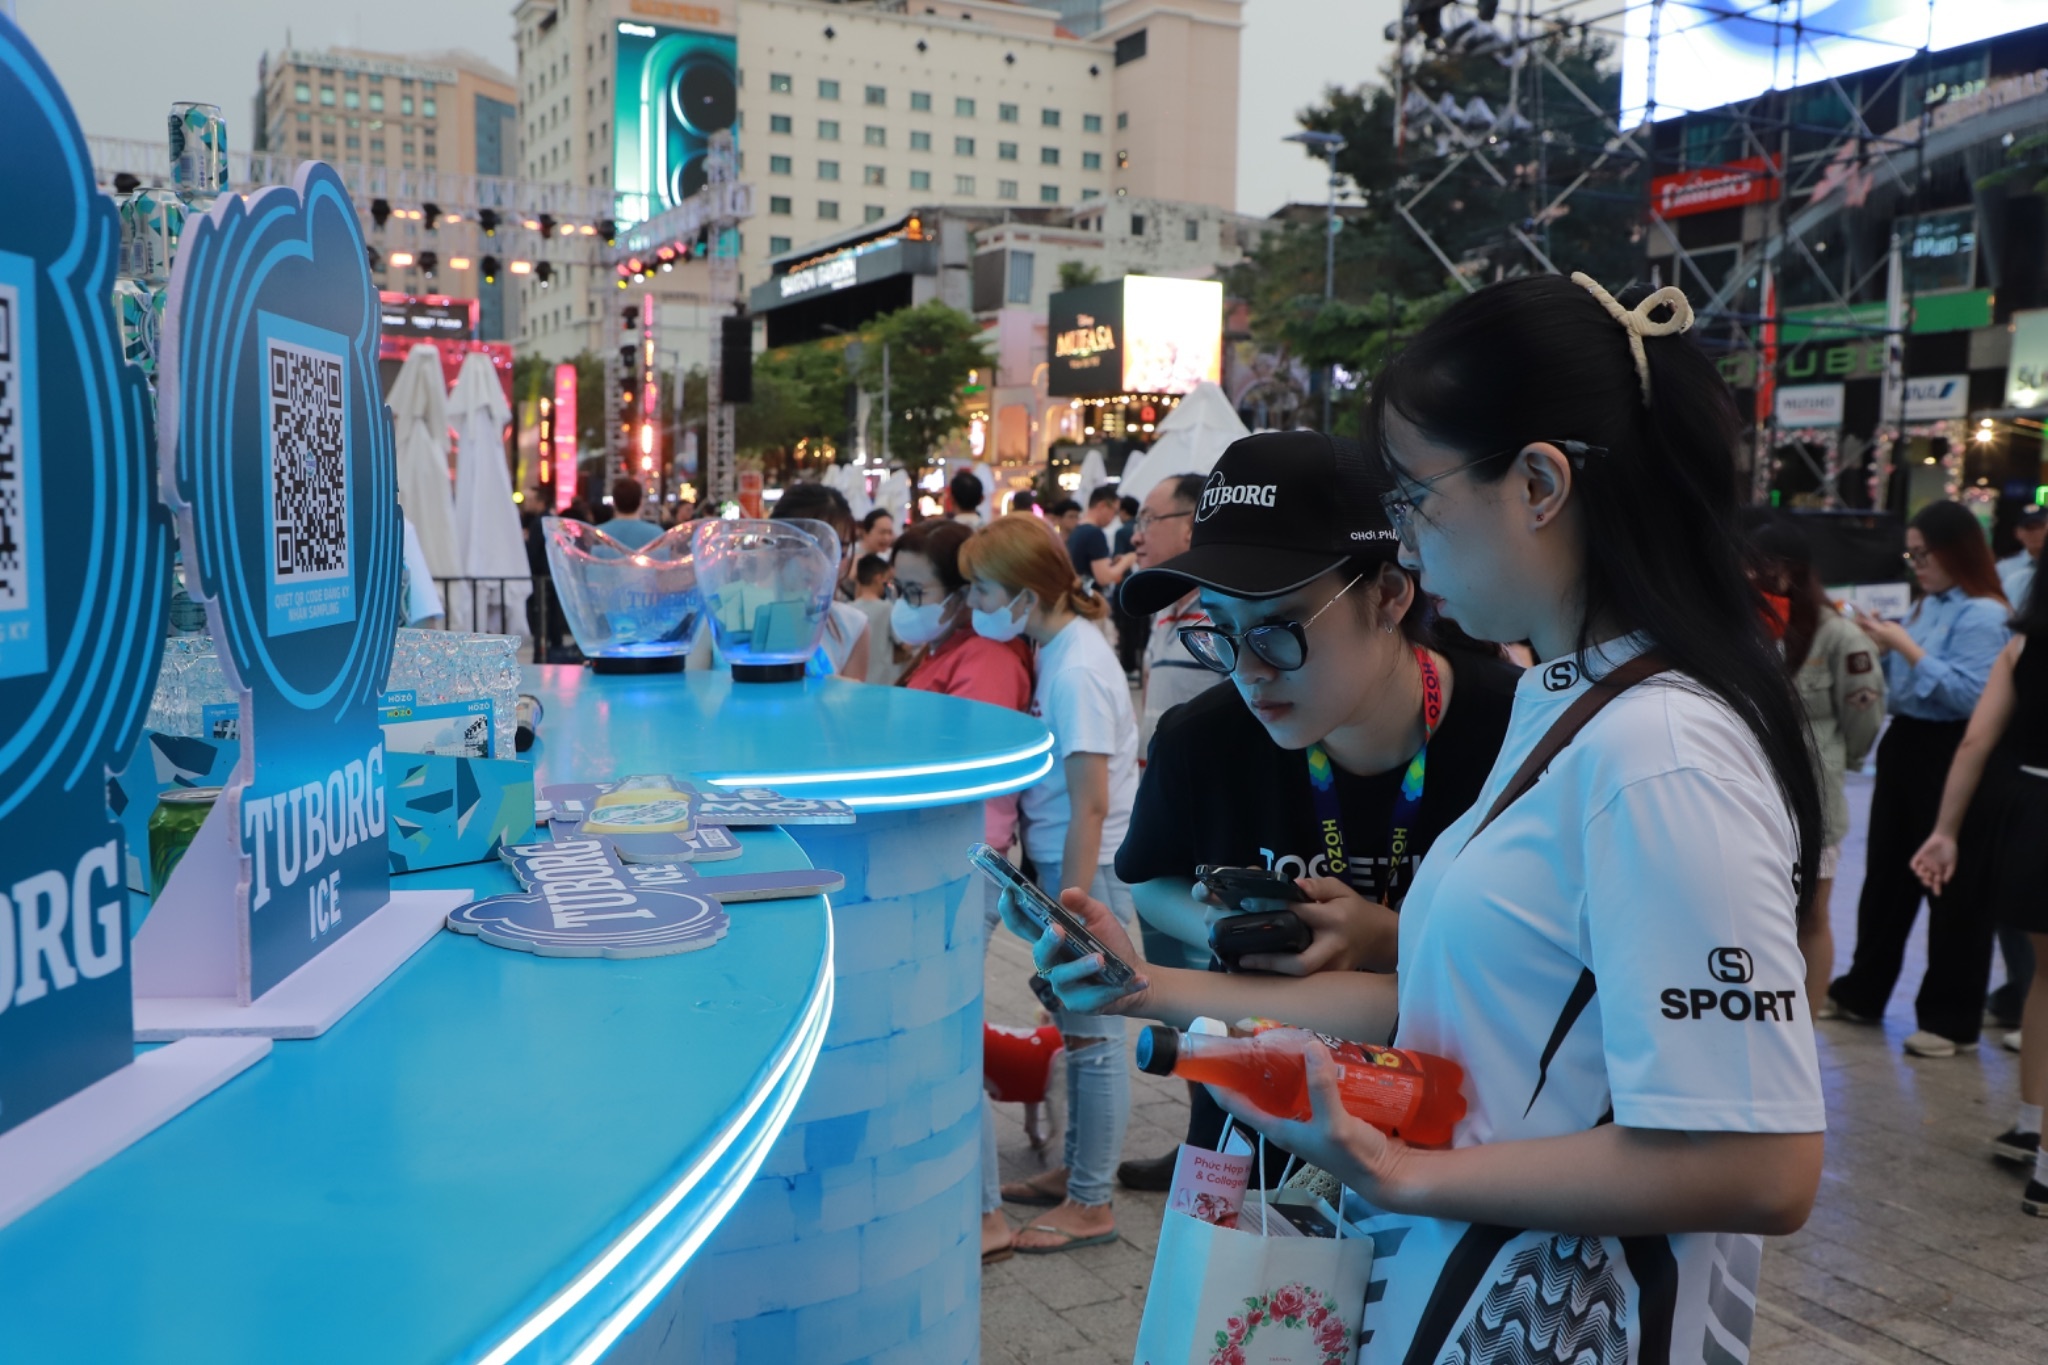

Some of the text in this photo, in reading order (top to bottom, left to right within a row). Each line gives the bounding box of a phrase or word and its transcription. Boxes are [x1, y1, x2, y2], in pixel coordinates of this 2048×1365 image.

[1201, 484, 1278, 512] TUBORG
[244, 742, 386, 913] TUBORG
[512, 839, 656, 929] TUBORG
[627, 863, 689, 887] ICE
[0, 838, 122, 1016] RG
[309, 870, 342, 940] ICE
[1661, 988, 1796, 1022] SPORT
[1195, 1171, 1204, 1181] &
